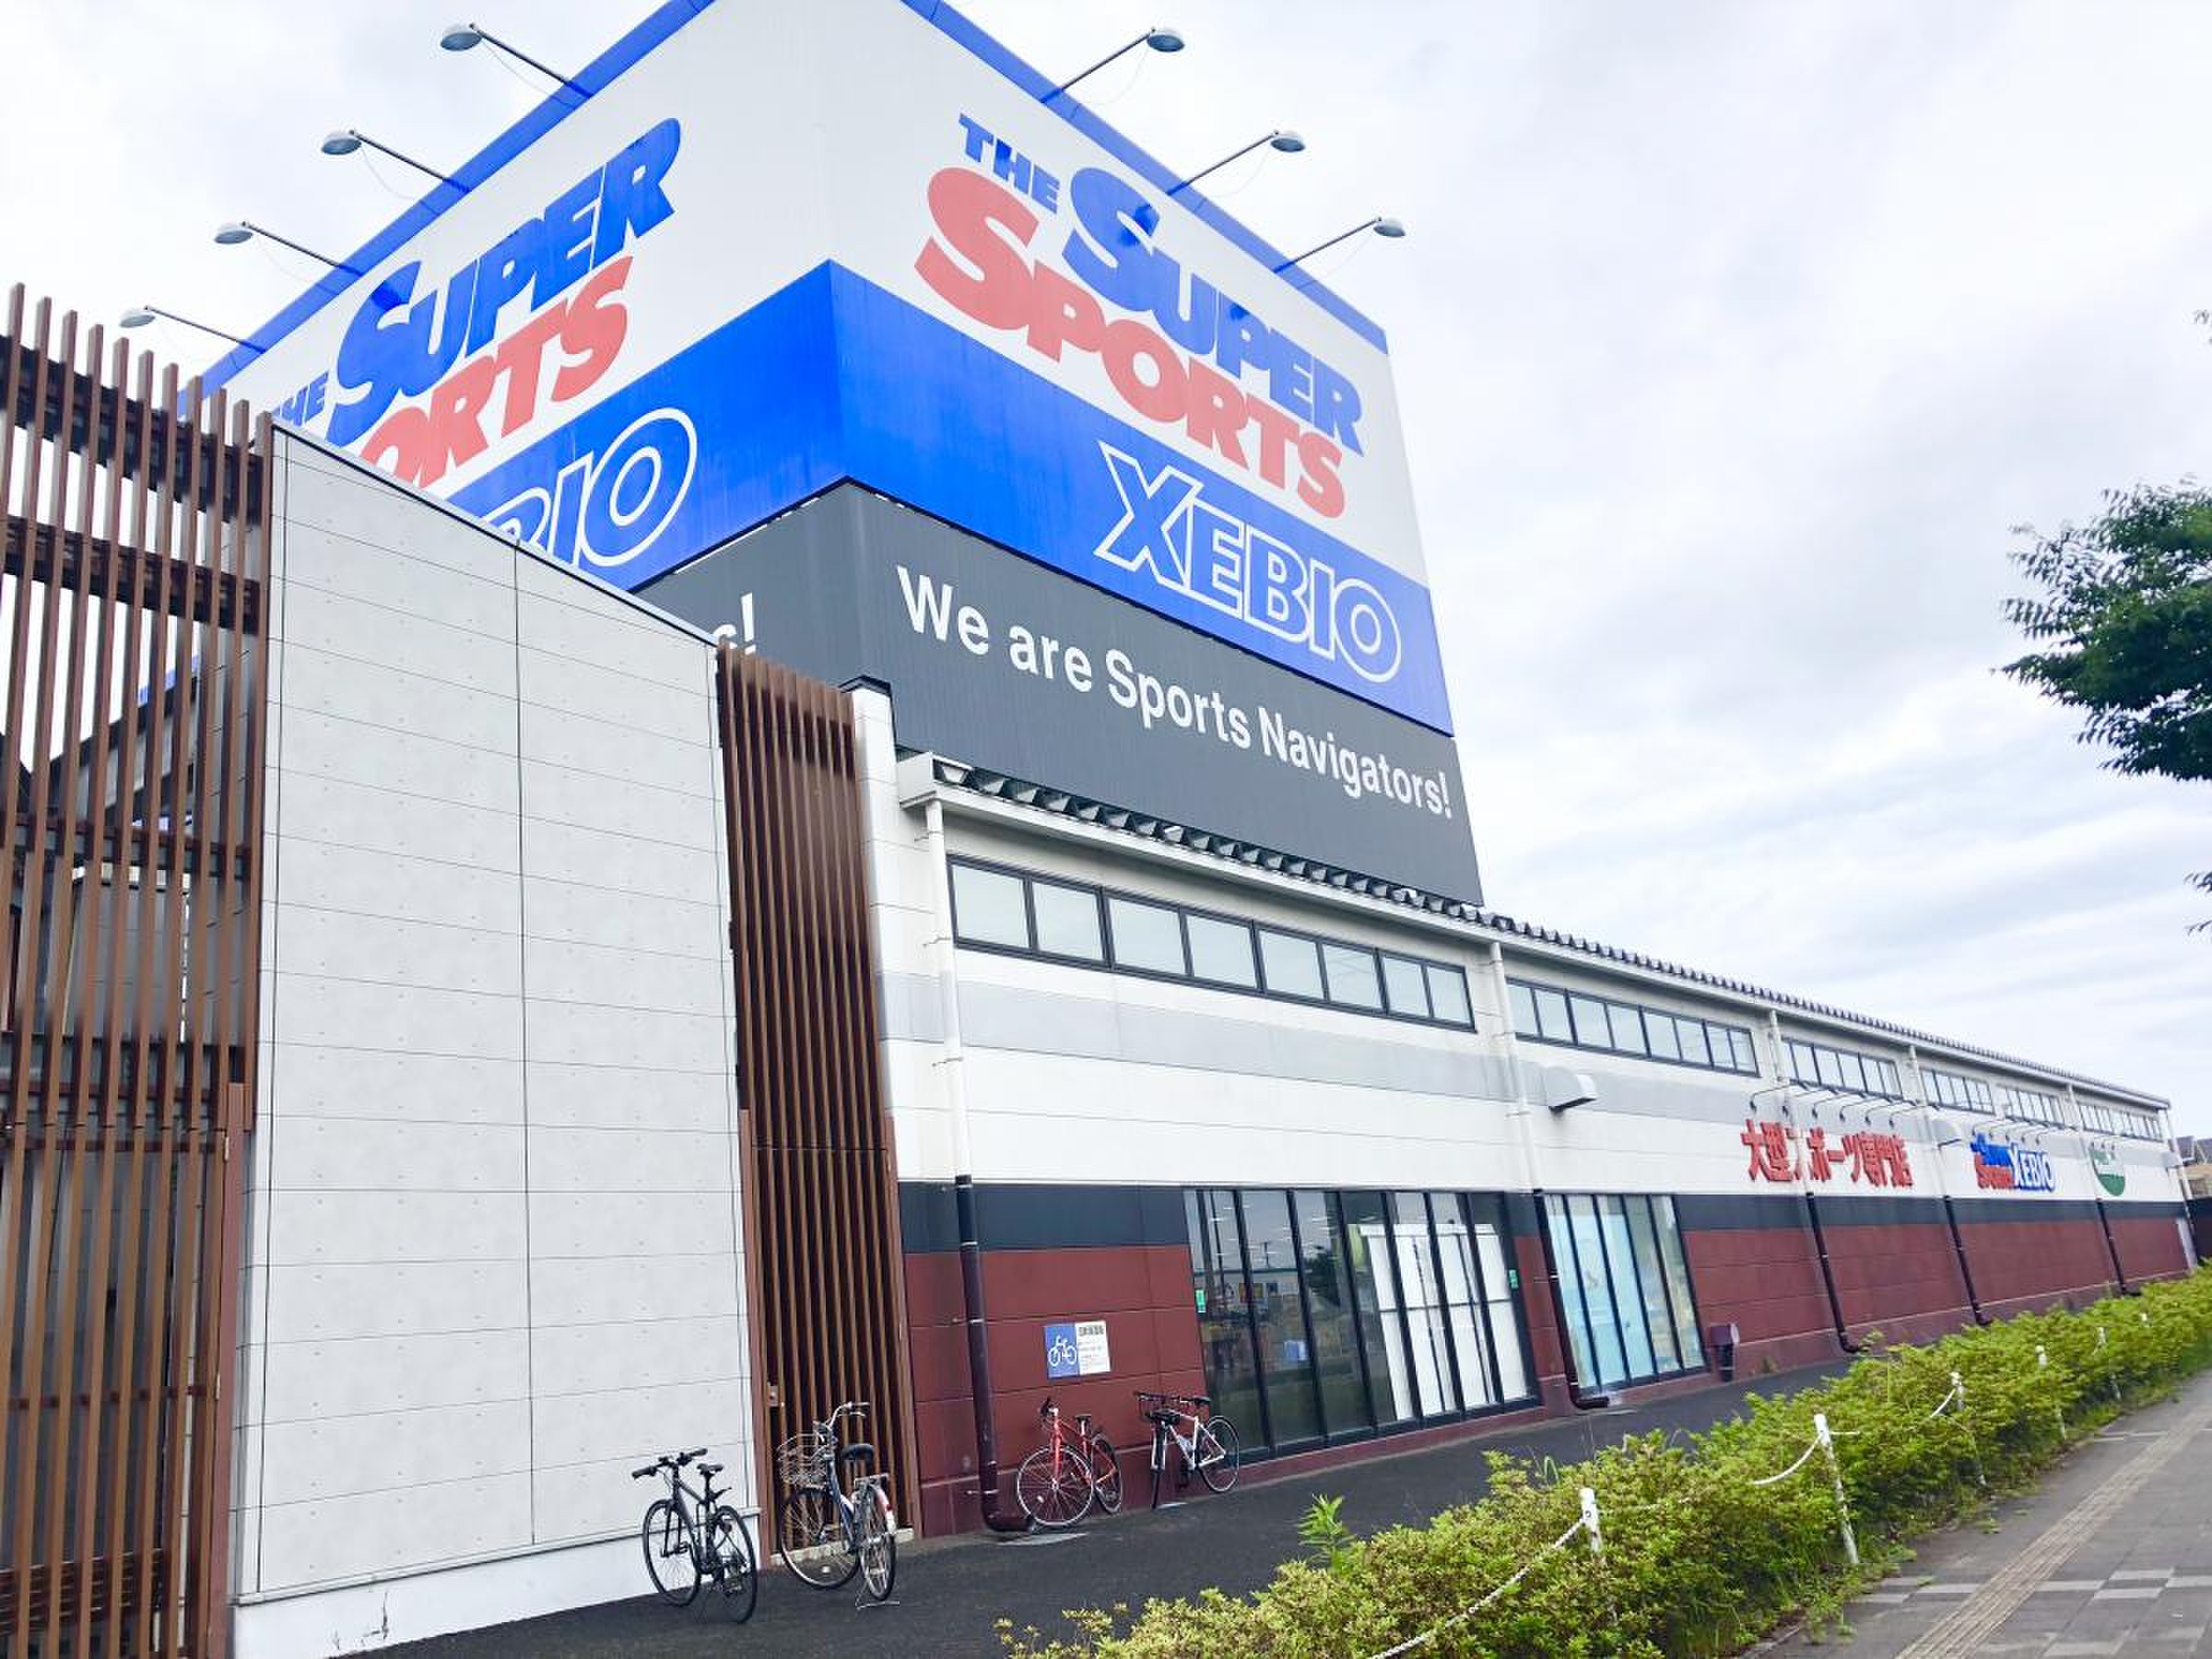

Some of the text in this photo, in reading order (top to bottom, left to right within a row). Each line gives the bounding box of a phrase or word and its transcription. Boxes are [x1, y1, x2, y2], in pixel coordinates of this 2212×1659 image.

[272, 117, 681, 448] HE SUPER
[914, 167, 1346, 519] SPORTS
[959, 112, 1365, 458] THE SUPER
[897, 565, 1453, 819] We are Sports Navigators!
[1094, 441, 1401, 683] XEBIO
[2008, 1141, 2055, 1193] XEBIO
